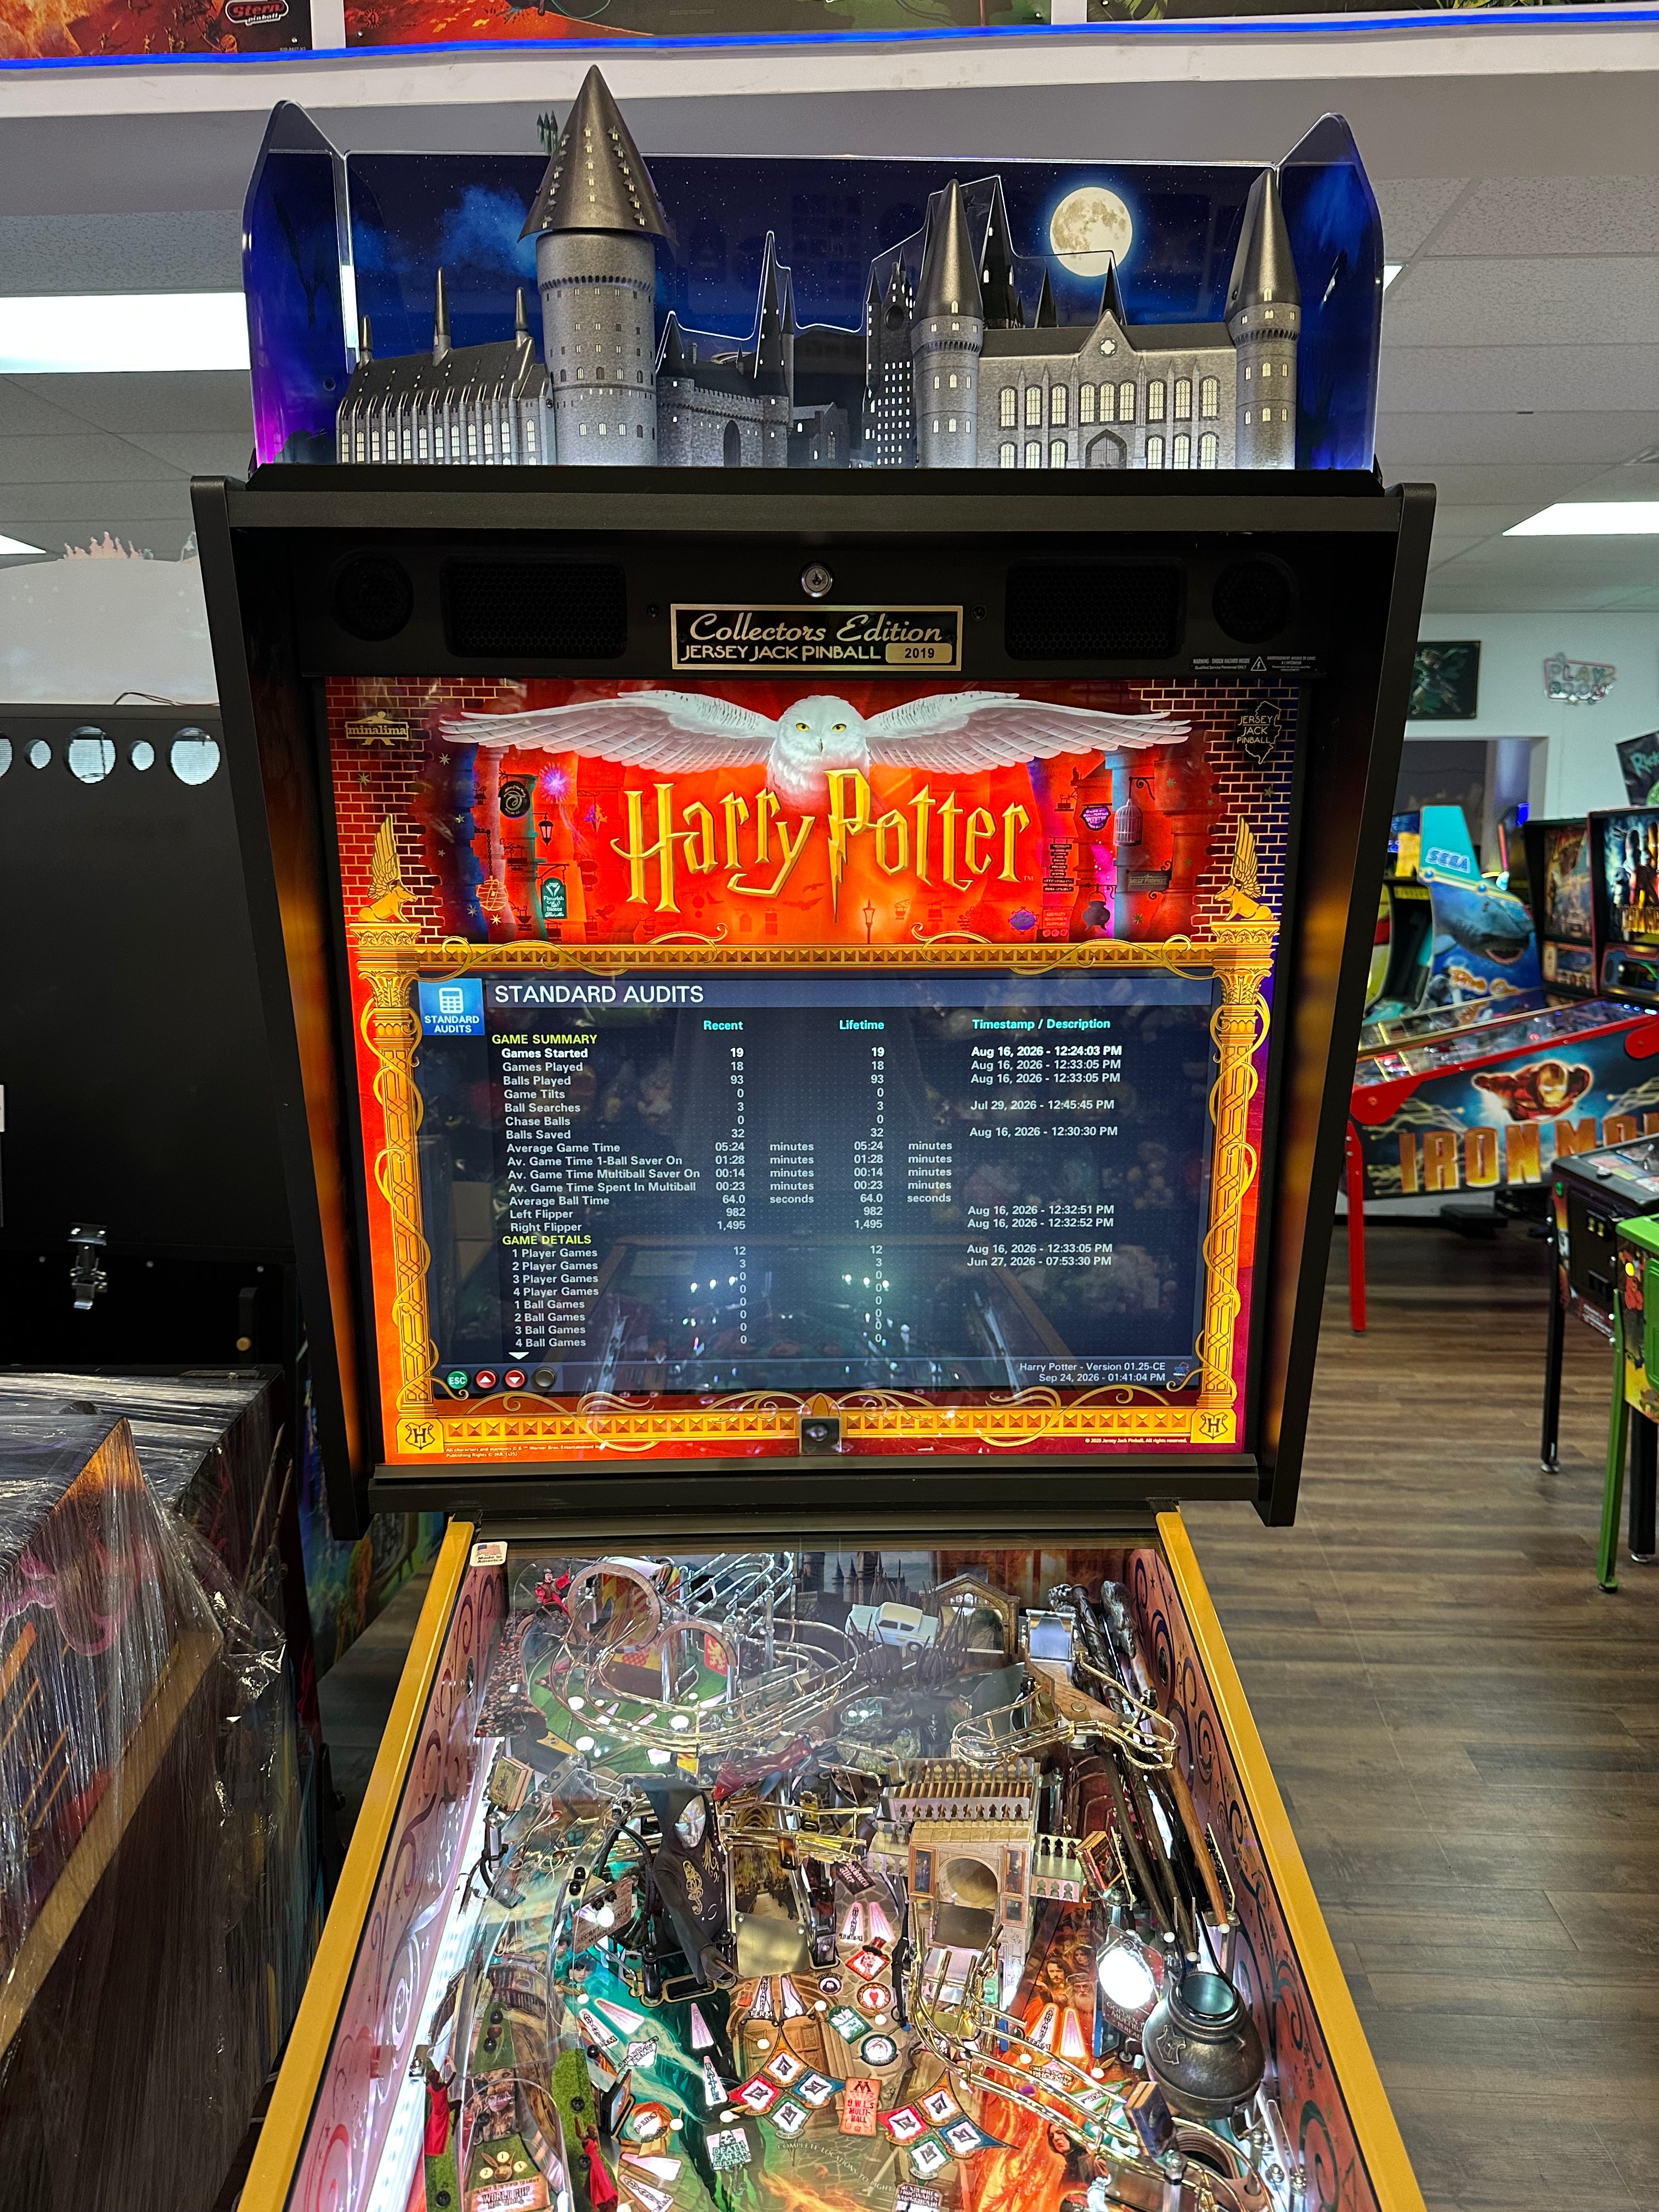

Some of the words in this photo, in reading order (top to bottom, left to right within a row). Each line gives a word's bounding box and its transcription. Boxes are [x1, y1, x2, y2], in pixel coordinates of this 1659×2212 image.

[233, 3, 281, 17] Stern
[247, 13, 279, 23] pinball
[690, 612, 825, 641] Collectors
[836, 613, 942, 642] Edition
[680, 646, 748, 661] JERSEY
[749, 646, 798, 662] JACK
[802, 646, 881, 662] PINBALL
[904, 647, 935, 659] 2019
[1238, 715, 1273, 726] JERSEY
[347, 725, 407, 735] minalima
[1241, 726, 1268, 737] JACK
[610, 783, 816, 913] Harry
[822, 768, 1030, 923] Potter
[1427, 849, 1469, 872] SEGA
[495, 985, 616, 1003] STANDARD
[623, 985, 704, 1003] AUDITS
[424, 1015, 479, 1024] STANDARD
[703, 1020, 743, 1030] Recent
[839, 1019, 884, 1030] Lifetime
[972, 1019, 1035, 1031] Timestamp
[1037, 1018, 1043, 1029] /
[1047, 1018, 1110, 1031] Description
[434, 1024, 472, 1034] AUDITS
[492, 1034, 528, 1044] GAME
[533, 1034, 597, 1044] SUMMARY
[501, 1048, 541, 1058] Games
[544, 1048, 588, 1058] Started
[730, 1047, 744, 1058] 19
[971, 1046, 994, 1059] Aug
[997, 1046, 1014, 1058] 16,
[1017, 1046, 1044, 1056] 2026
[1054, 1045, 1101, 1056] 12:24:03
[1103, 1045, 1122, 1056] PM
[503, 1062, 542, 1071] Games
[545, 1062, 583, 1074] Played
[731, 1061, 744, 1071] 18
[503, 1076, 530, 1085] Balls
[533, 1075, 571, 1087] Played
[730, 1075, 744, 1085] 93
[504, 1089, 537, 1099] Game
[540, 1089, 565, 1099] Tilts
[505, 1103, 525, 1113] Ball
[528, 1103, 581, 1113] Searches
[505, 1116, 540, 1126] Chase
[544, 1116, 571, 1126] Balls
[506, 1130, 533, 1139] Balls
[535, 1130, 571, 1139] Saved
[731, 1128, 745, 1138] 32
[506, 1143, 553, 1155] Average
[556, 1143, 589, 1152] Game
[592, 1143, 620, 1152] Time
[715, 1142, 745, 1152] 05:24
[770, 1142, 814, 1151] minutes
[507, 1156, 526, 1166] Av.
[529, 1156, 562, 1166] Game
[565, 1156, 593, 1165] Time
[597, 1156, 627, 1165] 1-Ball
[630, 1155, 663, 1165] Saver
[666, 1155, 682, 1165] On
[715, 1155, 745, 1165] 01:28
[1399, 1124, 1542, 1193] IRON
[507, 1170, 526, 1180] Av.
[530, 1170, 562, 1179] Game
[565, 1170, 594, 1179] Time
[597, 1169, 645, 1178] Multiball
[648, 1169, 681, 1178] Saver
[684, 1169, 700, 1178] On
[509, 1197, 555, 1207] Average
[558, 1196, 579, 1205] Ball
[582, 1195, 610, 1205] Time
[723, 1194, 746, 1204] 64.0
[510, 1209, 532, 1219] Left
[535, 1209, 573, 1221] Flipper
[726, 1207, 746, 1217] 982
[510, 1222, 541, 1234] Right
[544, 1222, 582, 1233] Flipper
[717, 1220, 746, 1231] 1,495
[502, 1235, 538, 1245] GAME
[541, 1235, 591, 1245] DETAILS
[733, 1246, 746, 1255] 12
[967, 1257, 988, 1266] Jun
[991, 1257, 1007, 1267] 27,
[1010, 1256, 1036, 1266] 2026
[1046, 1256, 1091, 1266] 07:53:30
[1093, 1256, 1111, 1265] PM
[515, 1339, 523, 1347] 4
[526, 1338, 545, 1347] Ball
[549, 1338, 586, 1347] Games
[1019, 1363, 1046, 1373] Harry
[1048, 1362, 1077, 1371] Potter
[1086, 1362, 1122, 1370] Version
[1124, 1362, 1166, 1370] 01.25-CE
[448, 1376, 466, 1385] ESC
[1039, 1373, 1058, 1383] Sep
[1060, 1373, 1074, 1383] 24,
[1076, 1373, 1099, 1381] 2026
[1108, 1373, 1147, 1381] 01:41:04
[1150, 1373, 1165, 1381] PM
[1207, 1418, 1221, 1433] H
[413, 1427, 426, 1443] H
[705, 2062, 721, 2101] BATTLE
[1032, 2070, 1070, 2086] PHOENIX
[851, 2115, 867, 2124] BALL
[713, 2140, 746, 2154] DEATH
[713, 2148, 748, 2161] EATER
[777, 2142, 817, 2151] COMPLETE
[821, 2147, 857, 2174] LOCATIONS
[860, 2173, 868, 2183] TO
[482, 2189, 514, 2204] WORLD
[514, 2186, 530, 2199] CUP
